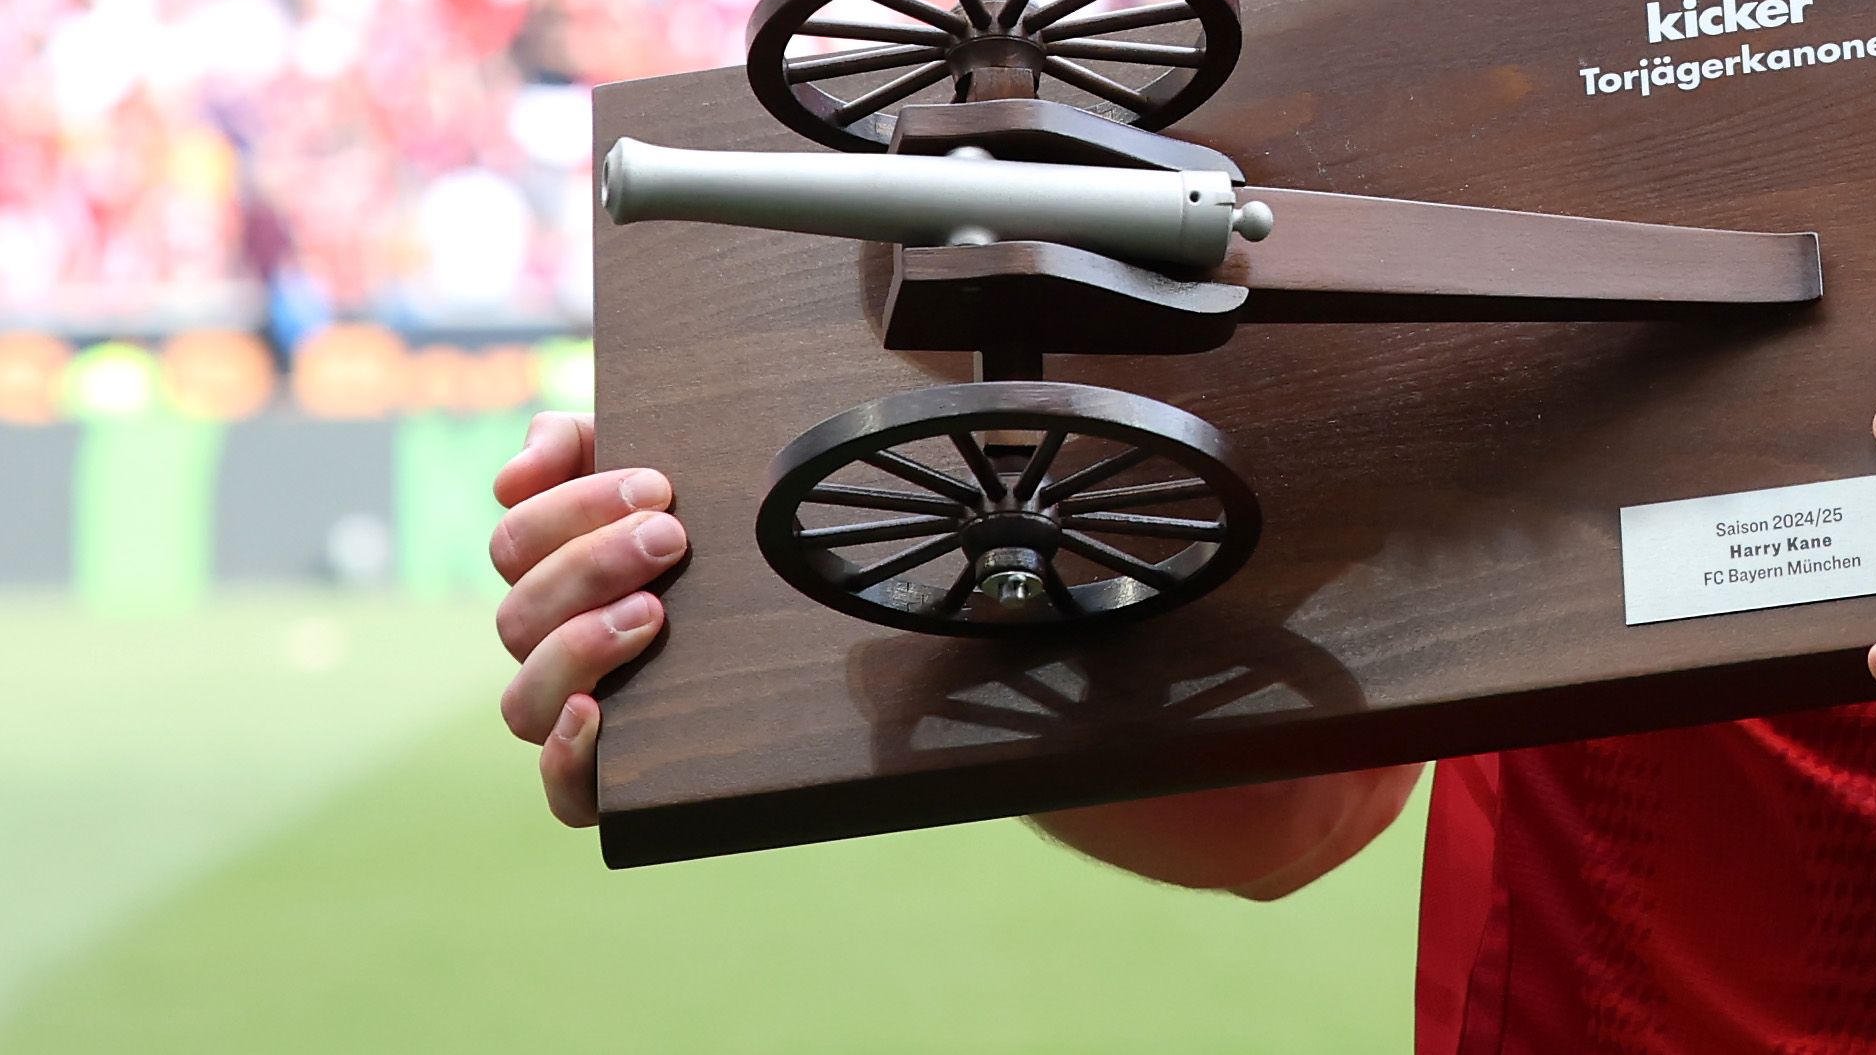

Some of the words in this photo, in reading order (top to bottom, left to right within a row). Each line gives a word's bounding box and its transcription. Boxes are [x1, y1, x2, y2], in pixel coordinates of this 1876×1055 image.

[1715, 519, 1769, 537] Saison
[1772, 507, 1843, 531] 2024/25
[1729, 540, 1782, 559] Harry
[1786, 534, 1833, 552] Kane
[1703, 570, 1724, 586] FC
[1728, 564, 1783, 585] Bayern
[1787, 554, 1862, 576] München
